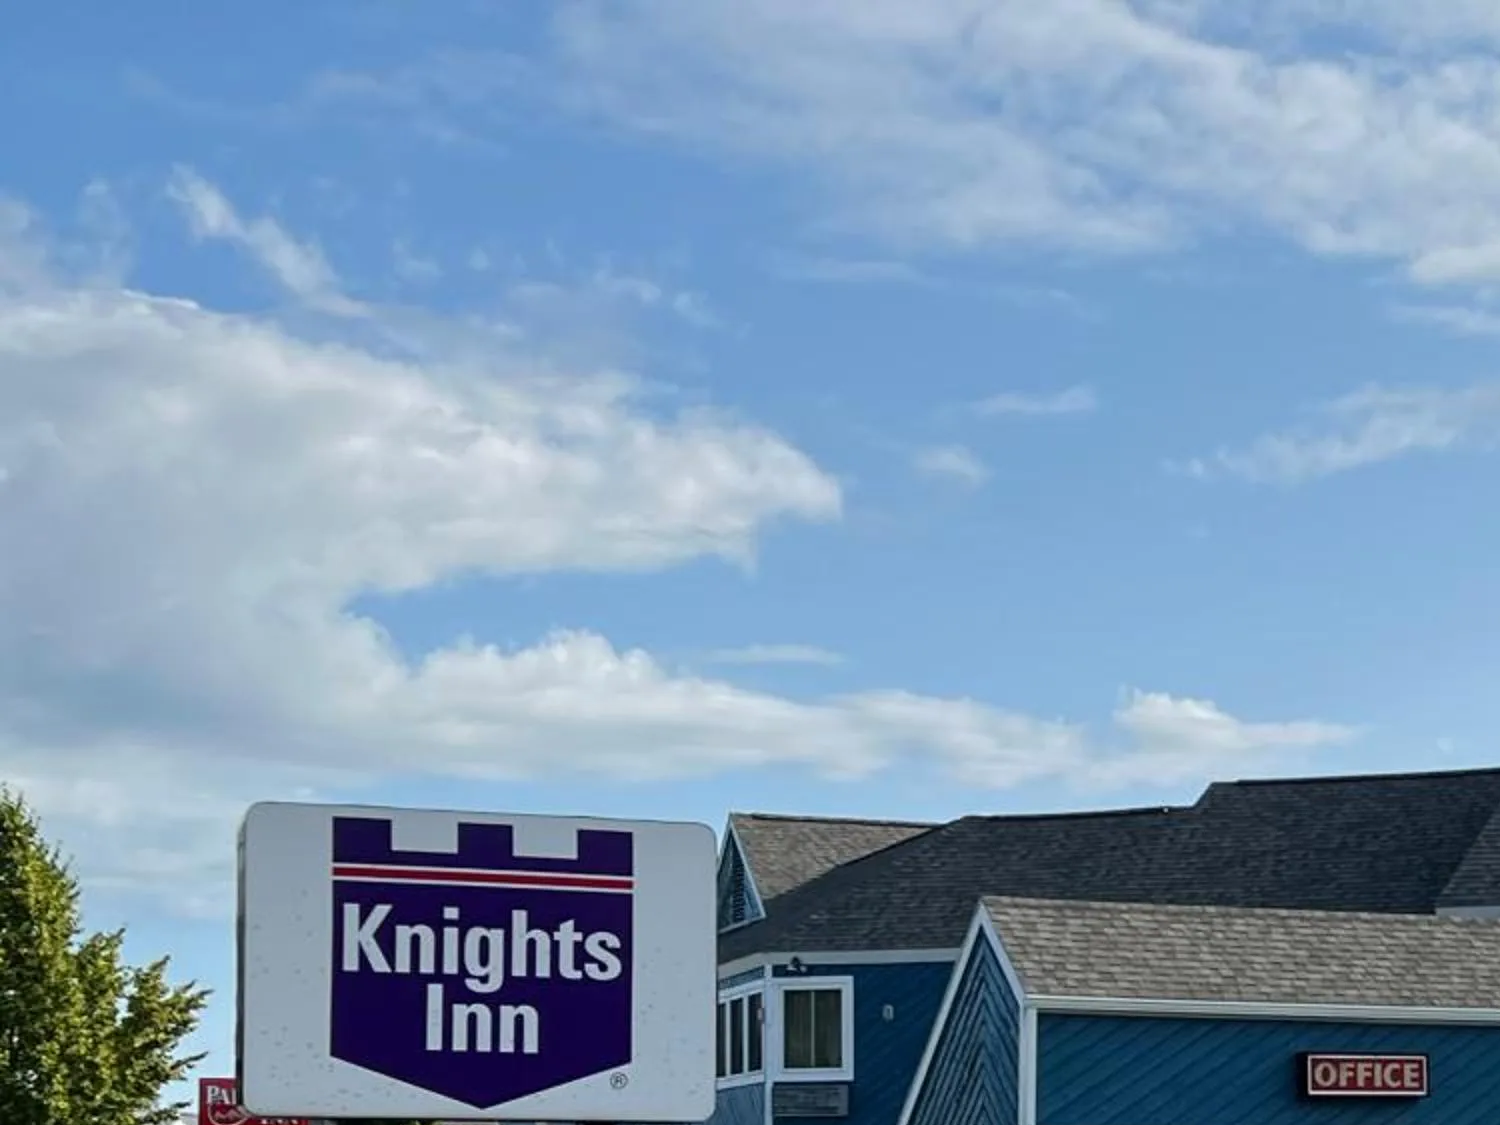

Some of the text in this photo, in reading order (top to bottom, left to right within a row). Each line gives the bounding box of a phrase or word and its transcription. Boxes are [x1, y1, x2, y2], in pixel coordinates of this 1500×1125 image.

[342, 903, 622, 993] Knights
[425, 984, 540, 1054] Inn
[1314, 1061, 1420, 1088] OFFICE
